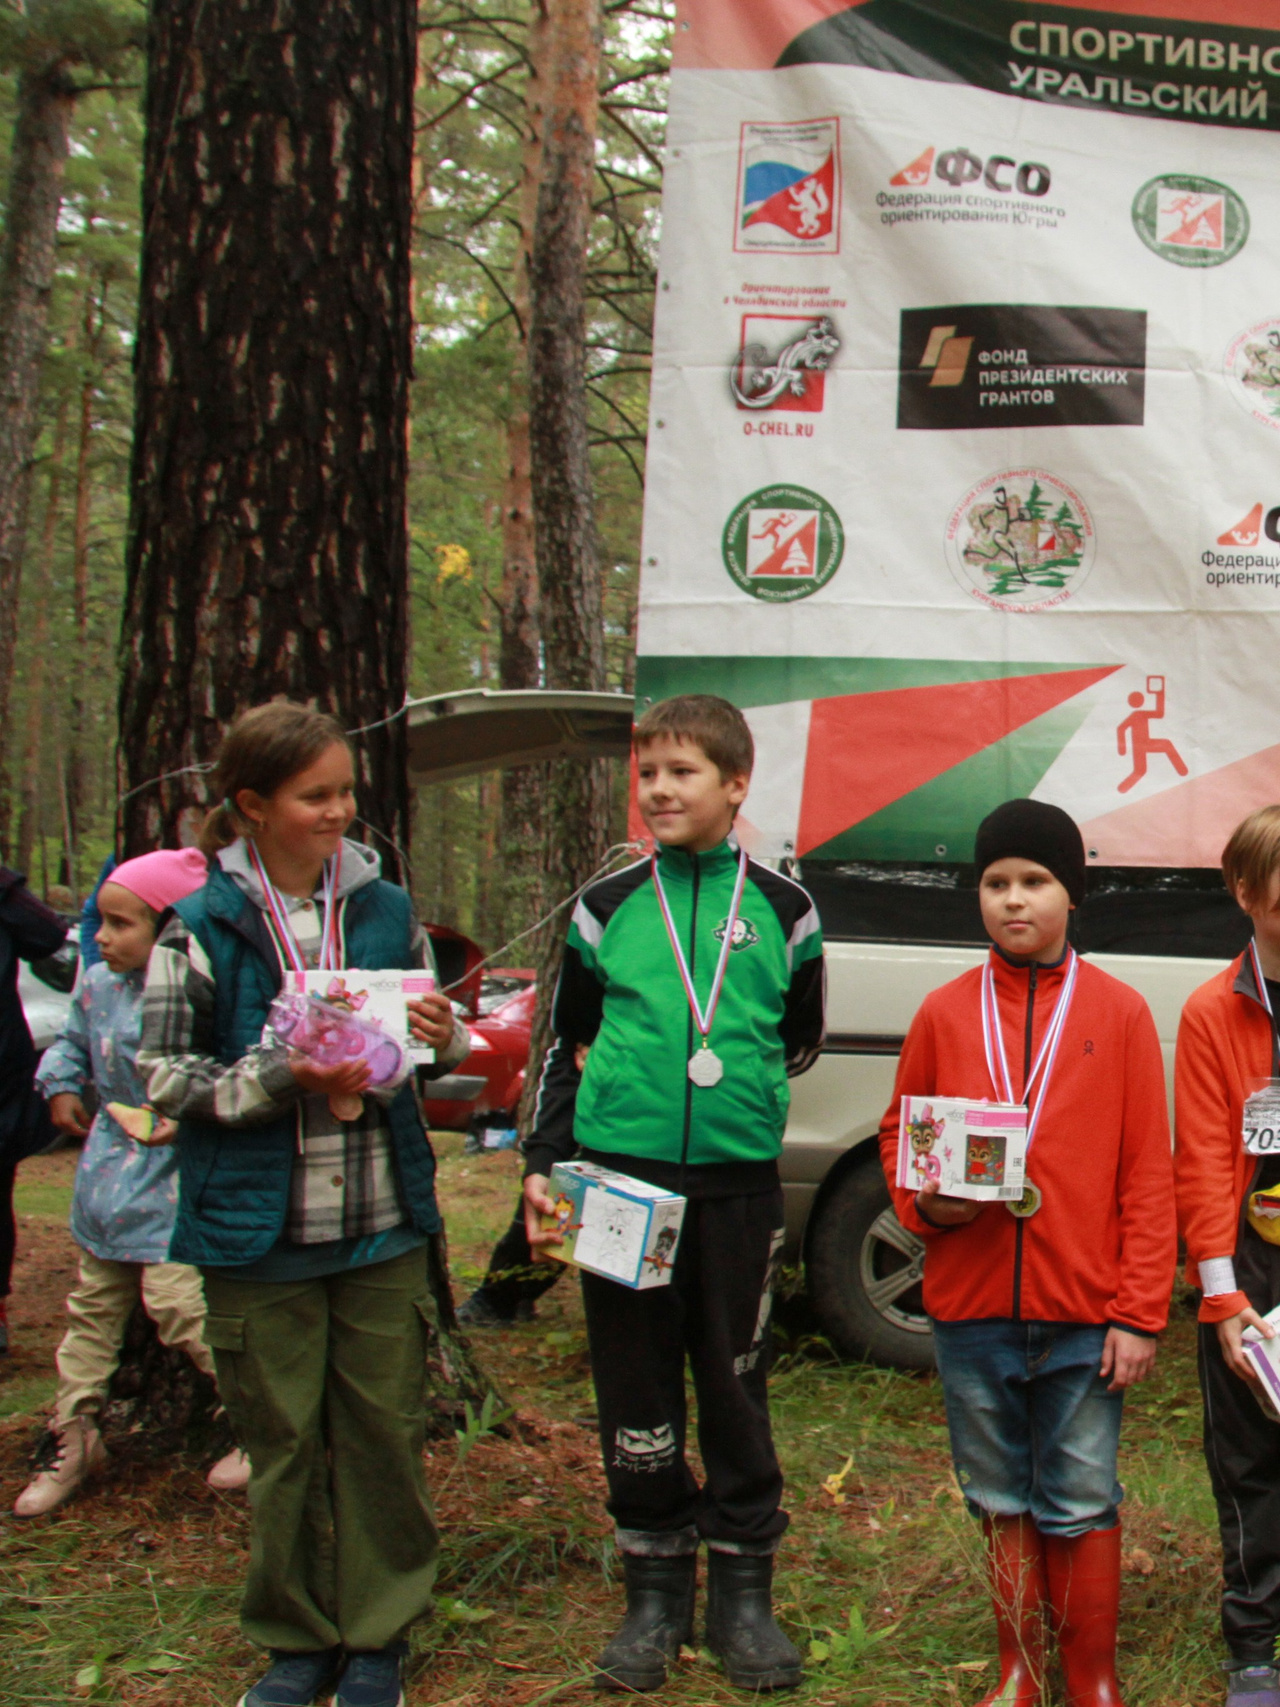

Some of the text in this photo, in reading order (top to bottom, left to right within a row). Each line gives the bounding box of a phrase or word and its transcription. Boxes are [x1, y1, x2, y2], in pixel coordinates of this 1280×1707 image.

[1007, 61, 1268, 120] УРАЛЬСКИЙ
[935, 146, 1052, 198] ФСО
[875, 190, 1067, 218] Федерация спортивного
[880, 207, 1059, 229] ориентирования Югры
[978, 348, 1029, 365] ФОНД
[978, 368, 1129, 386] ПРЕЗИДЕНТСКИХ
[979, 389, 1056, 407] ГРАНТОВ
[743, 420, 815, 438] O-CHEL.RU
